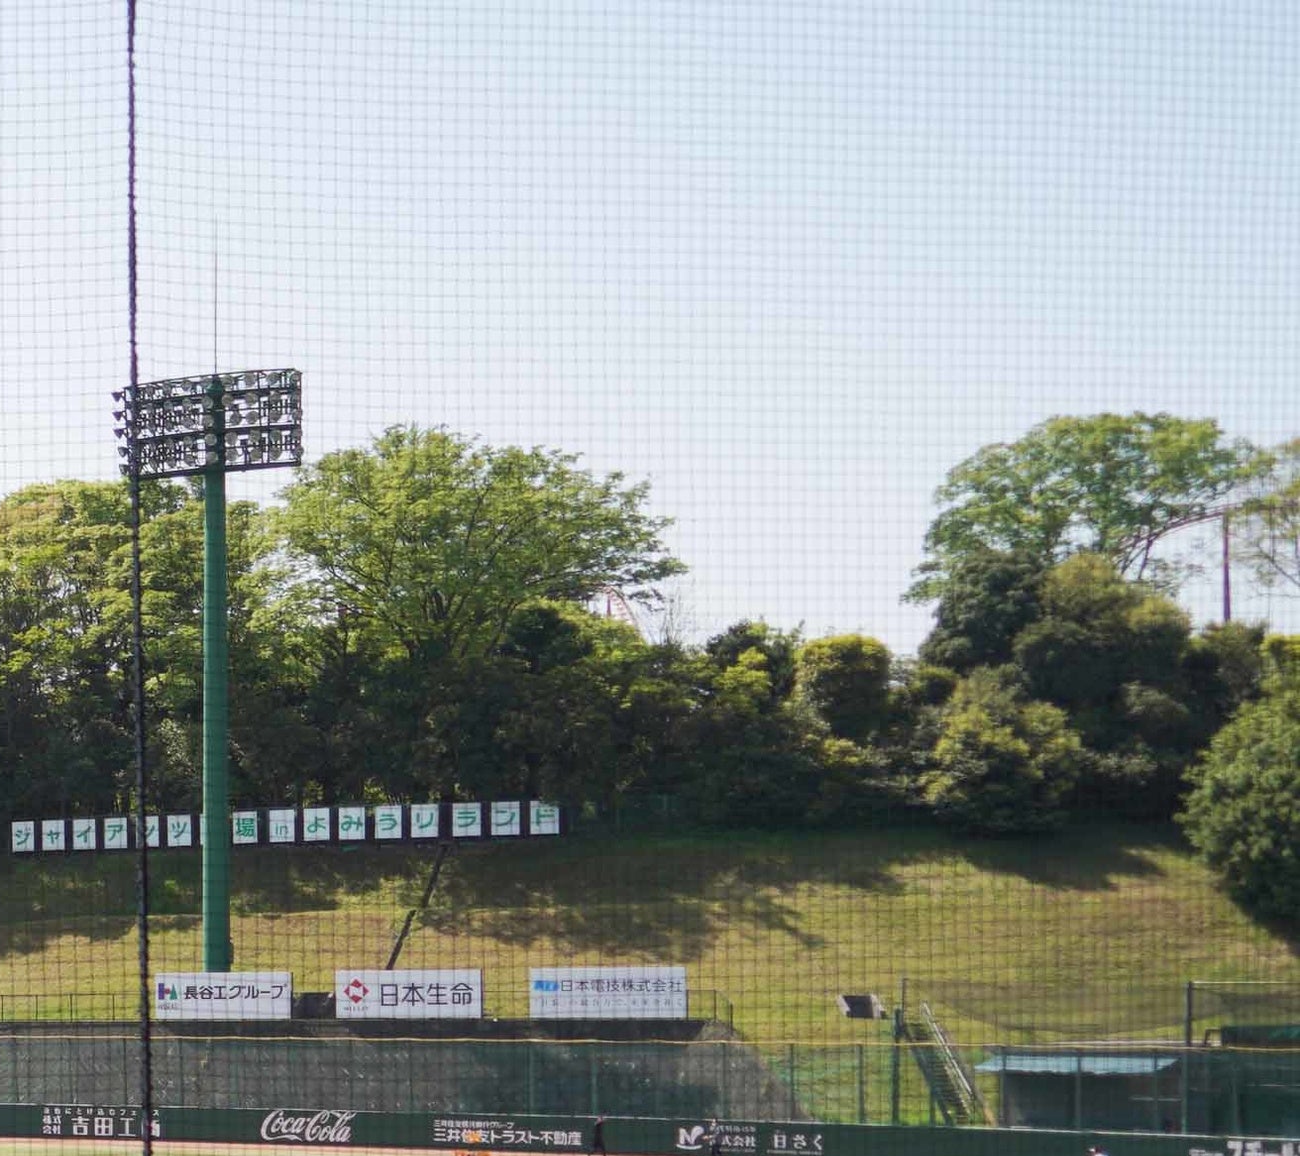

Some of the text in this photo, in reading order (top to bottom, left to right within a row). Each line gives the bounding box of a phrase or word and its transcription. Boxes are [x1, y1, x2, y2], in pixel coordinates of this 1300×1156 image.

[274, 823, 289, 836] in
[306, 808, 557, 835] よみうりランド
[183, 983, 288, 1000] 長谷工グループ
[380, 982, 474, 1007] 日本生命
[560, 979, 683, 993] 日本電技株式会社
[773, 1134, 823, 1150] 日さく
